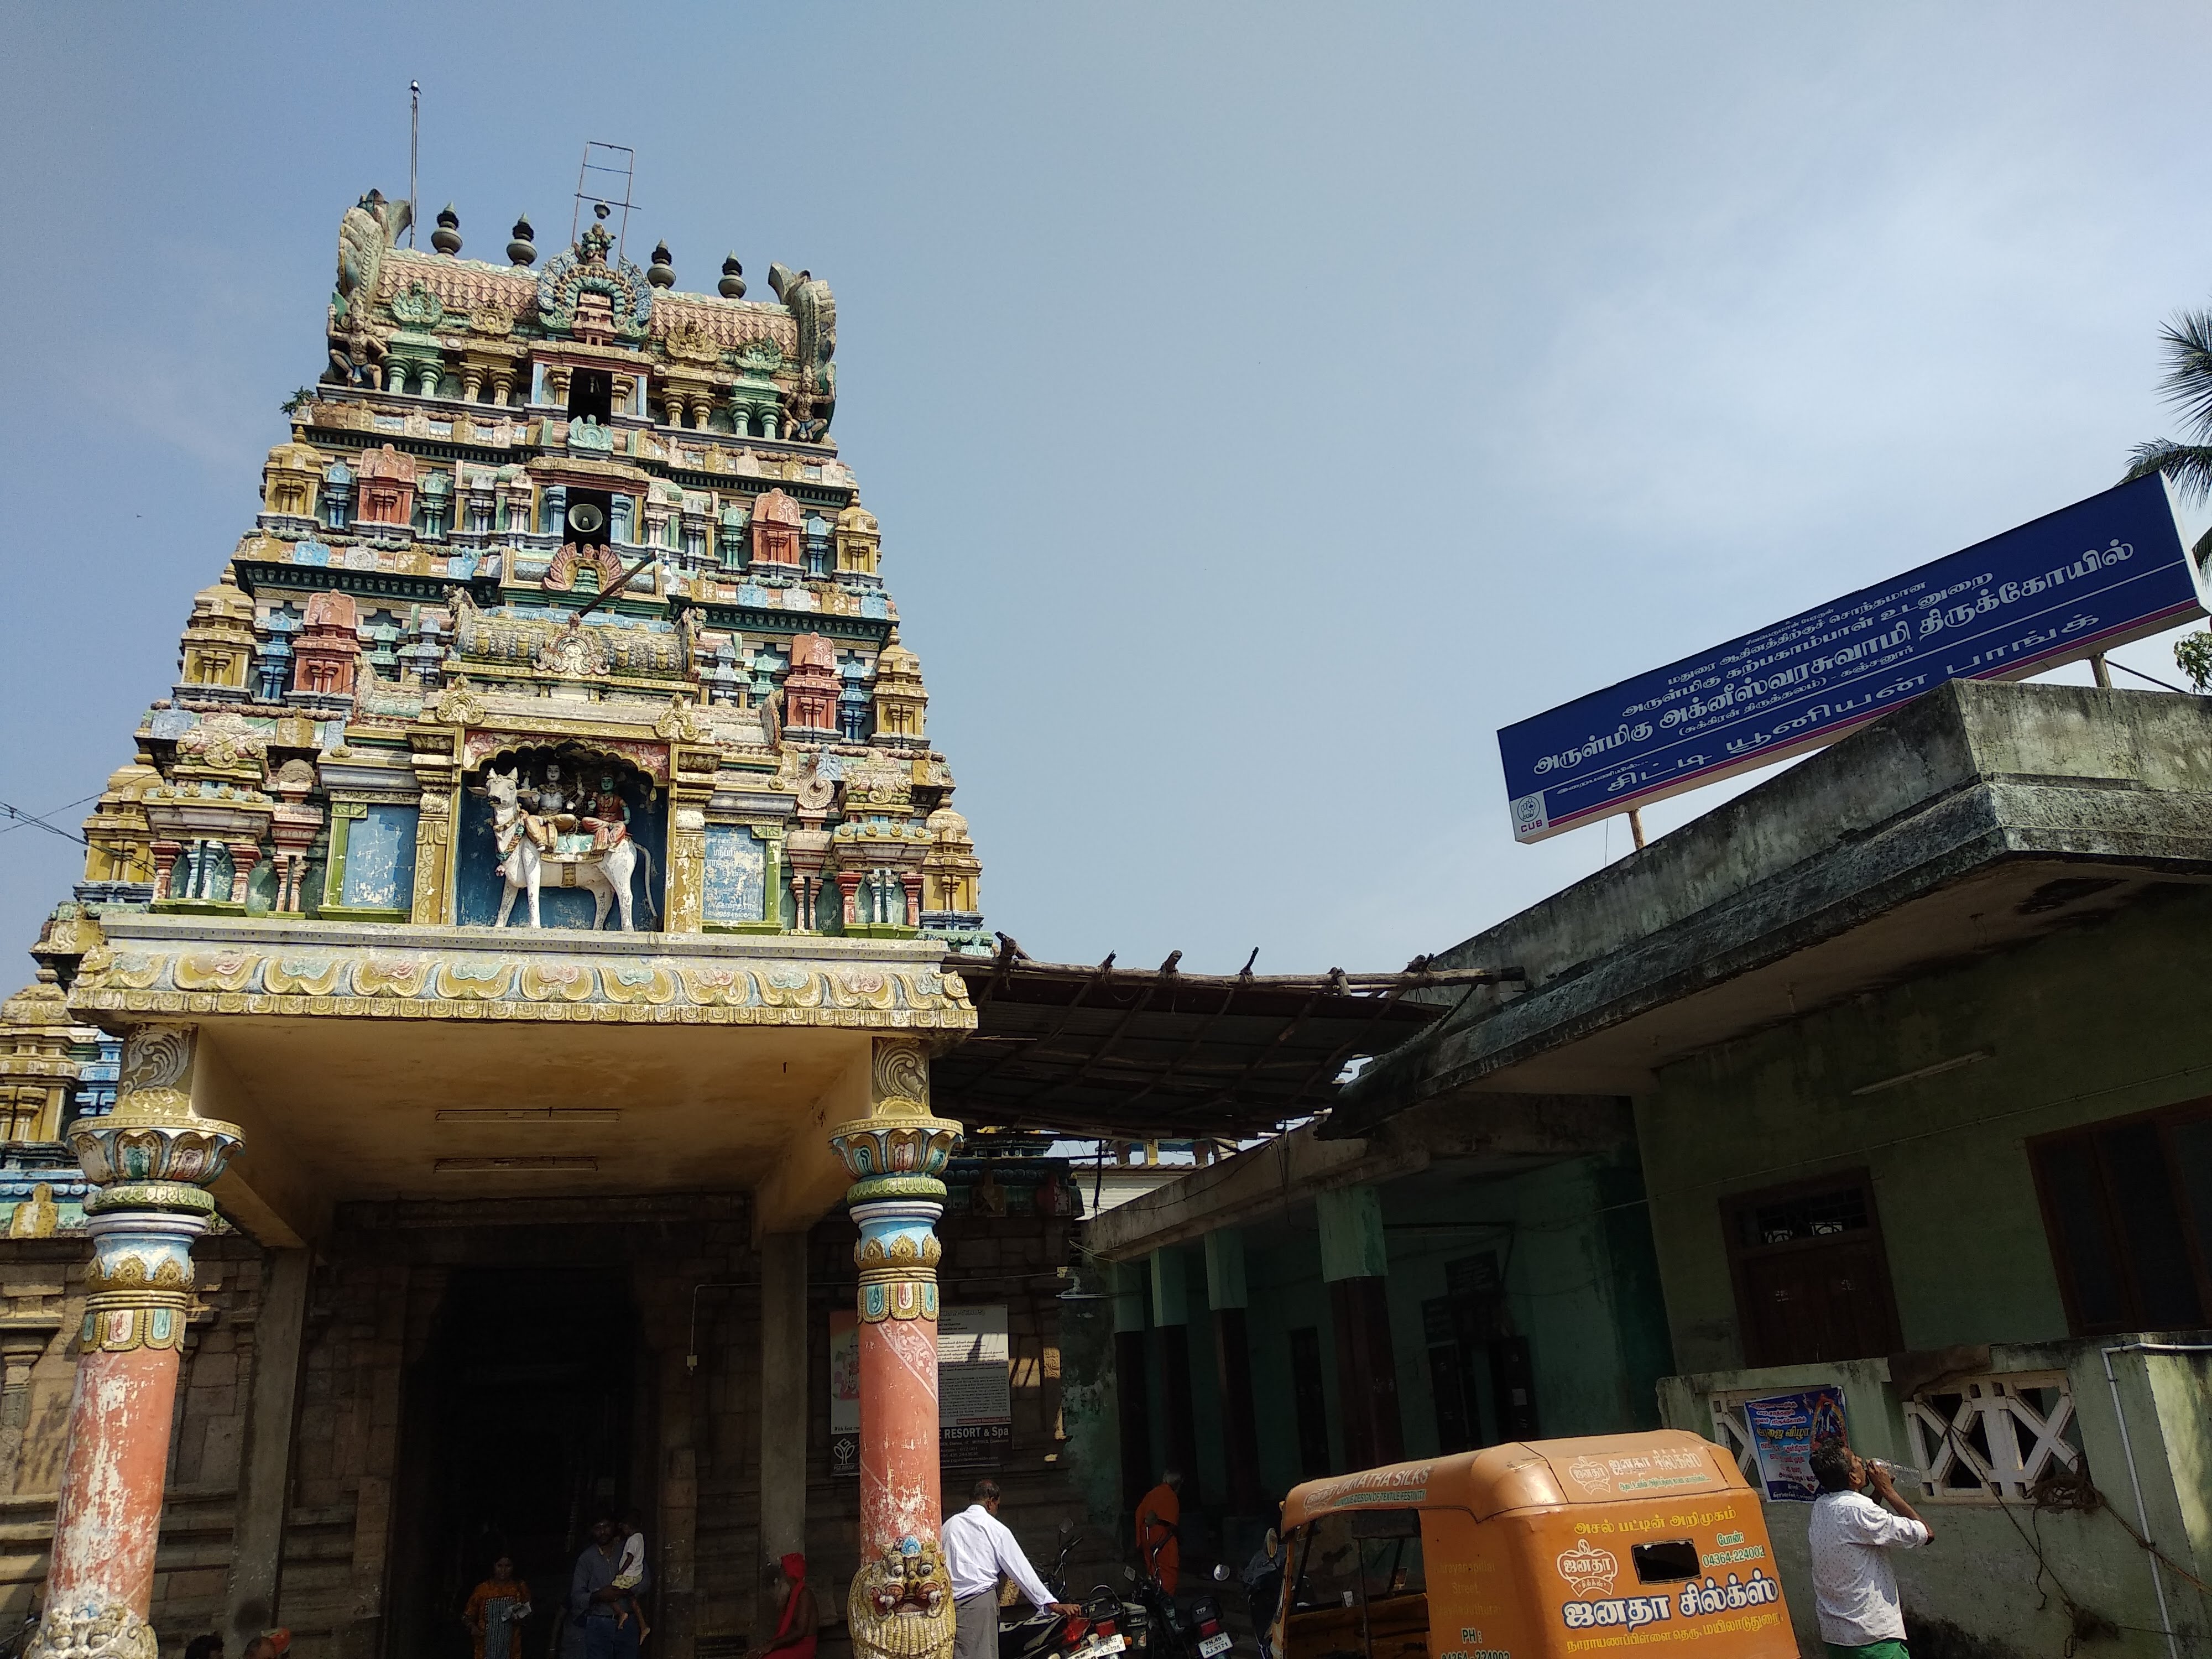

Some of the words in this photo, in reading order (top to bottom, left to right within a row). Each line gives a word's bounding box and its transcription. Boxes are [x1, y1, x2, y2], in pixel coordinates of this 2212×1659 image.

[1668, 662, 1715, 685] மதுரை
[1829, 581, 1927, 624] சொந்தமான
[1622, 675, 1721, 717] அருள்மிகு
[1726, 616, 1874, 679] கற்பகாம்பாள்
[1880, 572, 1993, 622] உடனுறை
[1533, 721, 1653, 775] அருள்மிகு
[1660, 620, 1911, 729] அக்னீஸ்வரசுவாமி
[1919, 539, 2135, 641] திருக்கோயில்
[1679, 708, 1740, 736] (சுக்கிரன்
[1743, 677, 1827, 713] திருத்தலம்)
[1840, 645, 1914, 677] கஞ்சனூர்
[1607, 754, 1712, 792] சிட்டி
[1726, 674, 1928, 754] யூனியன்
[1946, 613, 2100, 675] பாங்க்
[1521, 819, 1543, 833] CUB
[944, 1427, 982, 1439] RESORT
[983, 1428, 990, 1437] &
[992, 1426, 1009, 1438] Spa
[1785, 1425, 1811, 1440] விழா
[1337, 1472, 1393, 1495] JANATHA
[1392, 1466, 1432, 1487] SILKS
[1355, 1493, 1372, 1503] DESIGN
[1372, 1493, 1380, 1501] OF
[1381, 1491, 1401, 1501] TEXTILE
[1574, 1519, 1615, 1535] அசல்
[1619, 1514, 1666, 1533] பட்டின்
[1670, 1505, 1737, 1527] அறிமுகம்
[1716, 1530, 1745, 1547] போன்:
[1563, 1557, 1612, 1577] ஜனதா
[1702, 1546, 1765, 1568] 04364-224002
[1564, 1597, 1670, 1631] ஜனதா
[1680, 1568, 1779, 1616] சில்க்ஸ்
[1099, 1645, 1121, 1655] A.3298
[1204, 1636, 1222, 1647] TN.49
[1206, 1642, 1228, 1655] AJ.3171
[1567, 1631, 1671, 1654] நாராயணப்பிள்ளை
